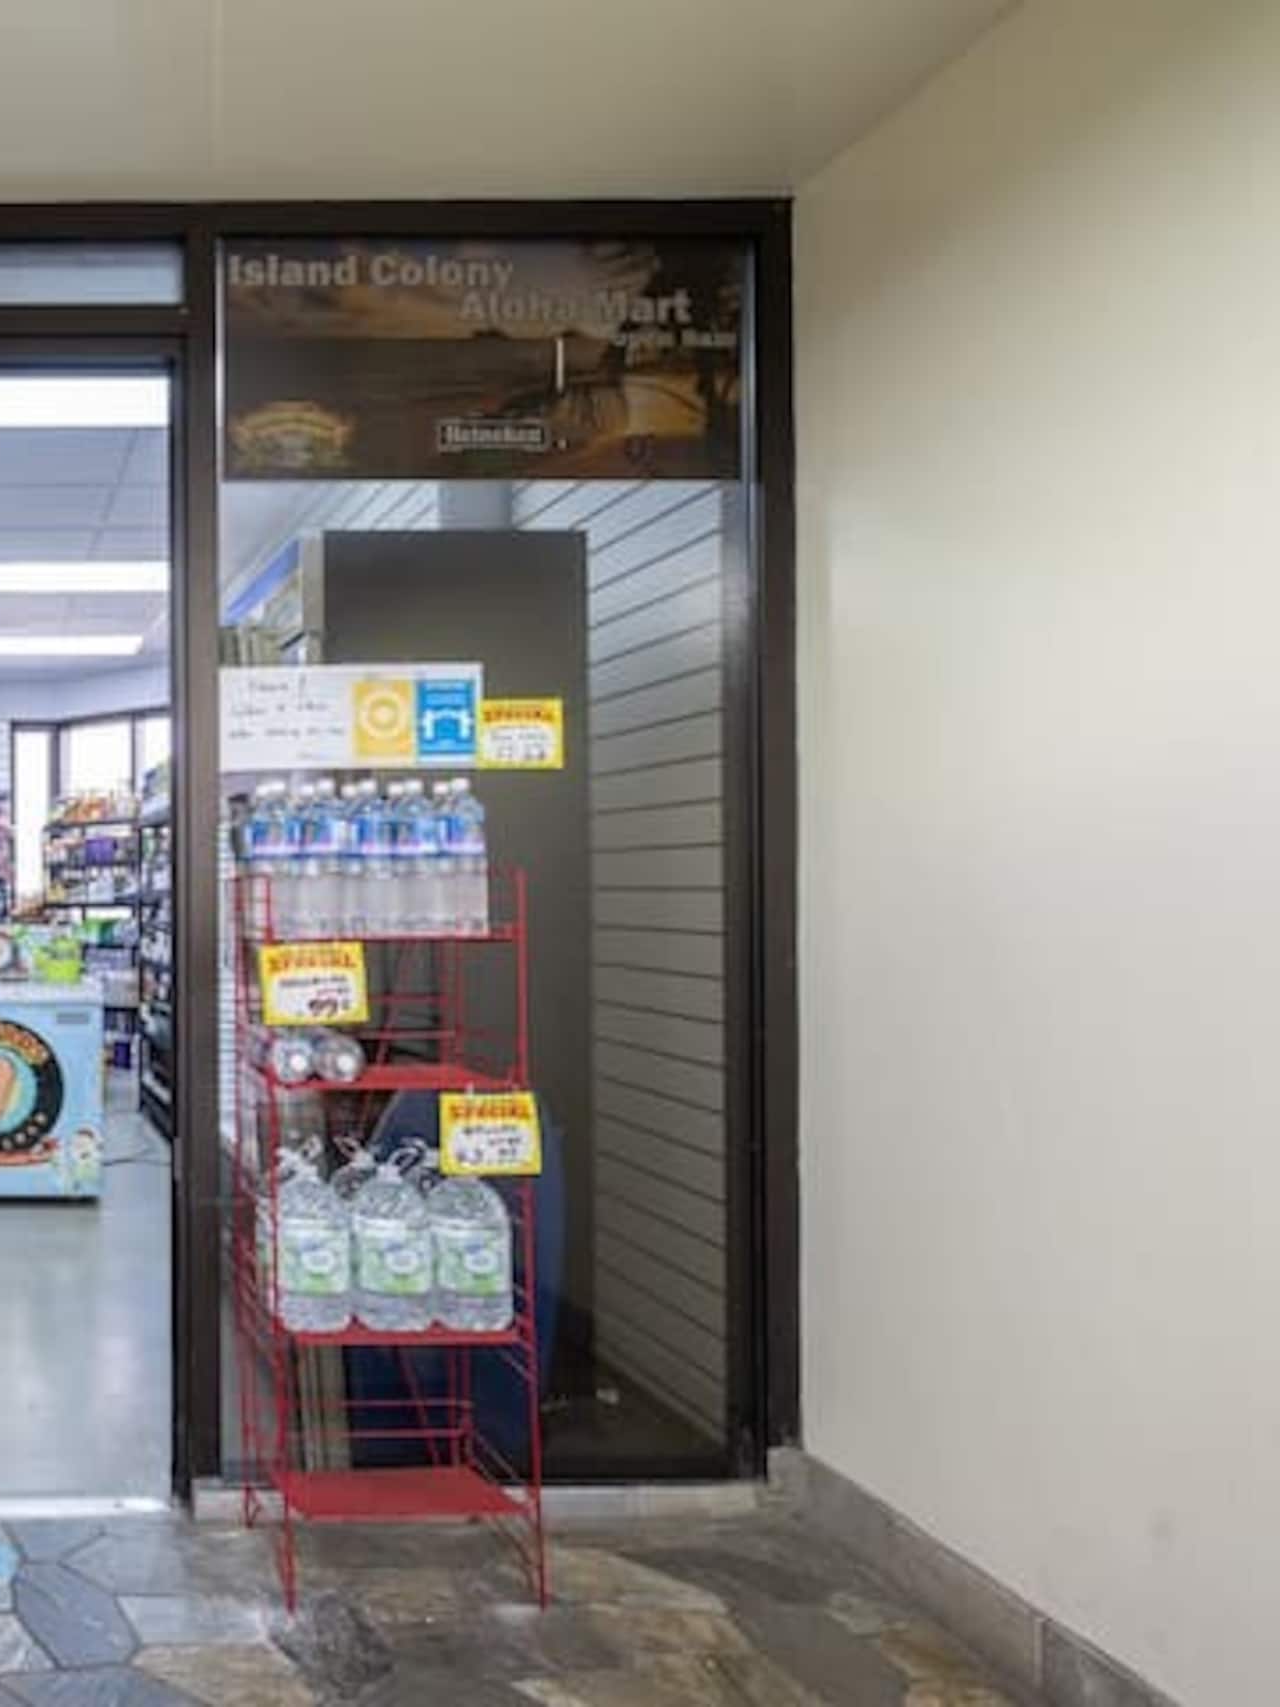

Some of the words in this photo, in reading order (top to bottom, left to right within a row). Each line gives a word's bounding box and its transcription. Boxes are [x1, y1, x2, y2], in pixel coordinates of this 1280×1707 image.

[227, 255, 358, 288] Island
[370, 255, 515, 297] Colony
[458, 292, 588, 324] Aloha
[597, 289, 694, 324] Mart
[443, 423, 544, 446] Heineken
[267, 951, 358, 975] SPECIAL
